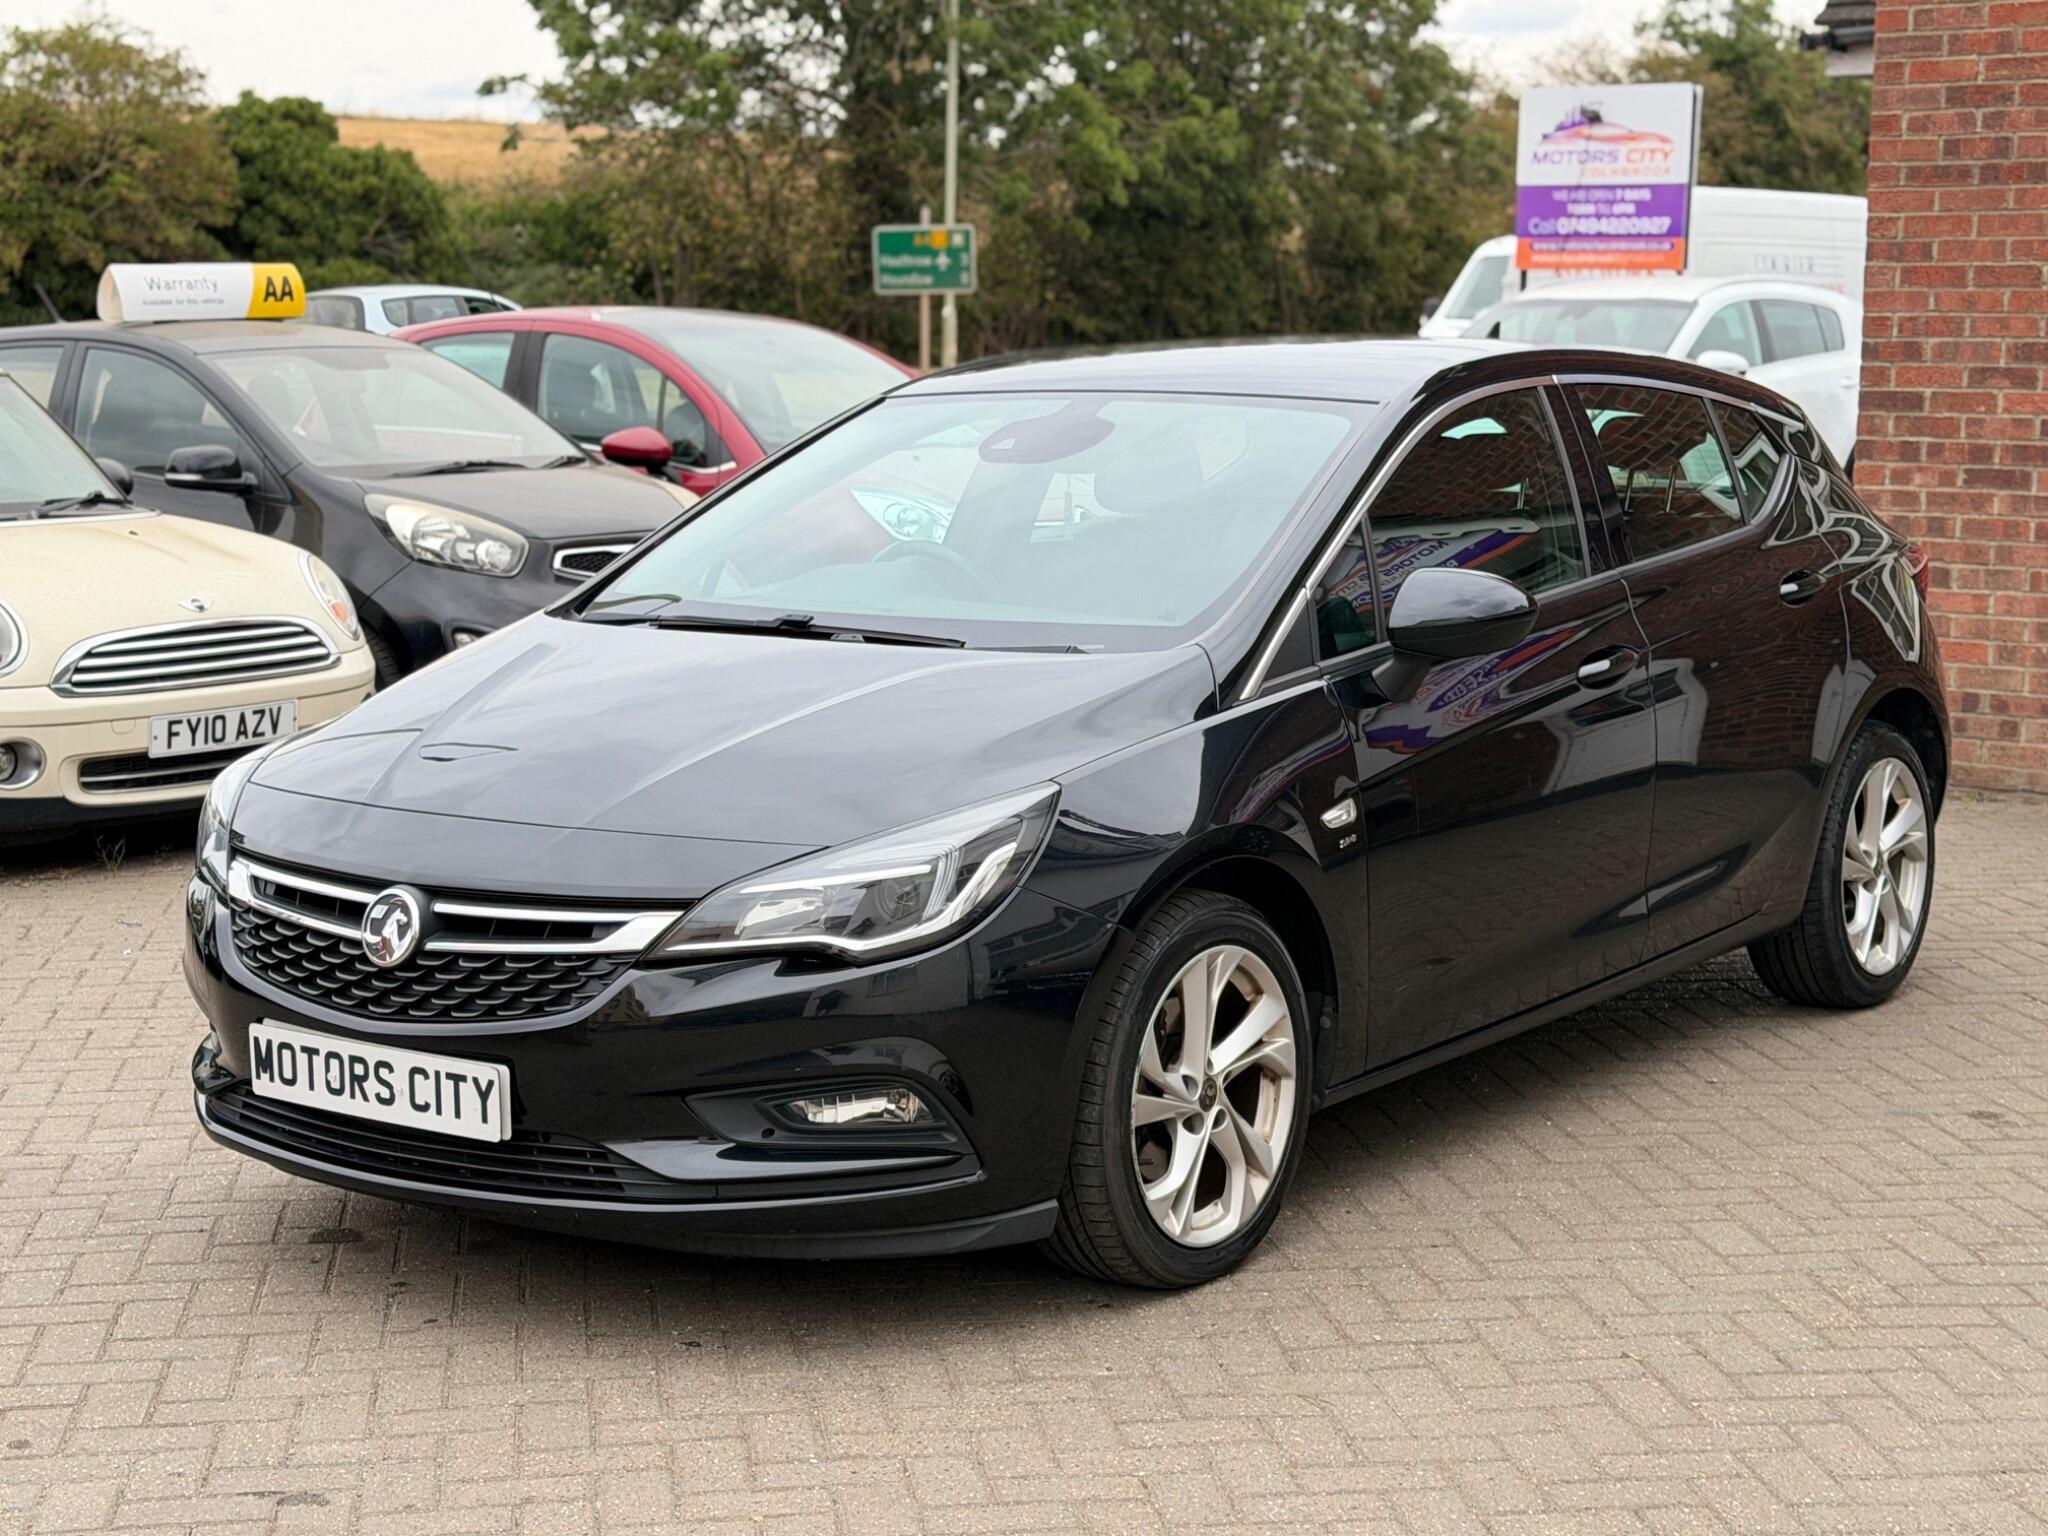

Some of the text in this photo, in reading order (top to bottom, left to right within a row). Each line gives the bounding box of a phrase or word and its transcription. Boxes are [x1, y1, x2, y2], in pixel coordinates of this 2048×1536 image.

[1532, 148, 1673, 164] MOTORS CITY
[144, 276, 218, 292] Warranty
[264, 276, 294, 302] AA
[167, 706, 281, 749] FY10 AZV
[253, 1036, 495, 1124] MOTORS CITY
